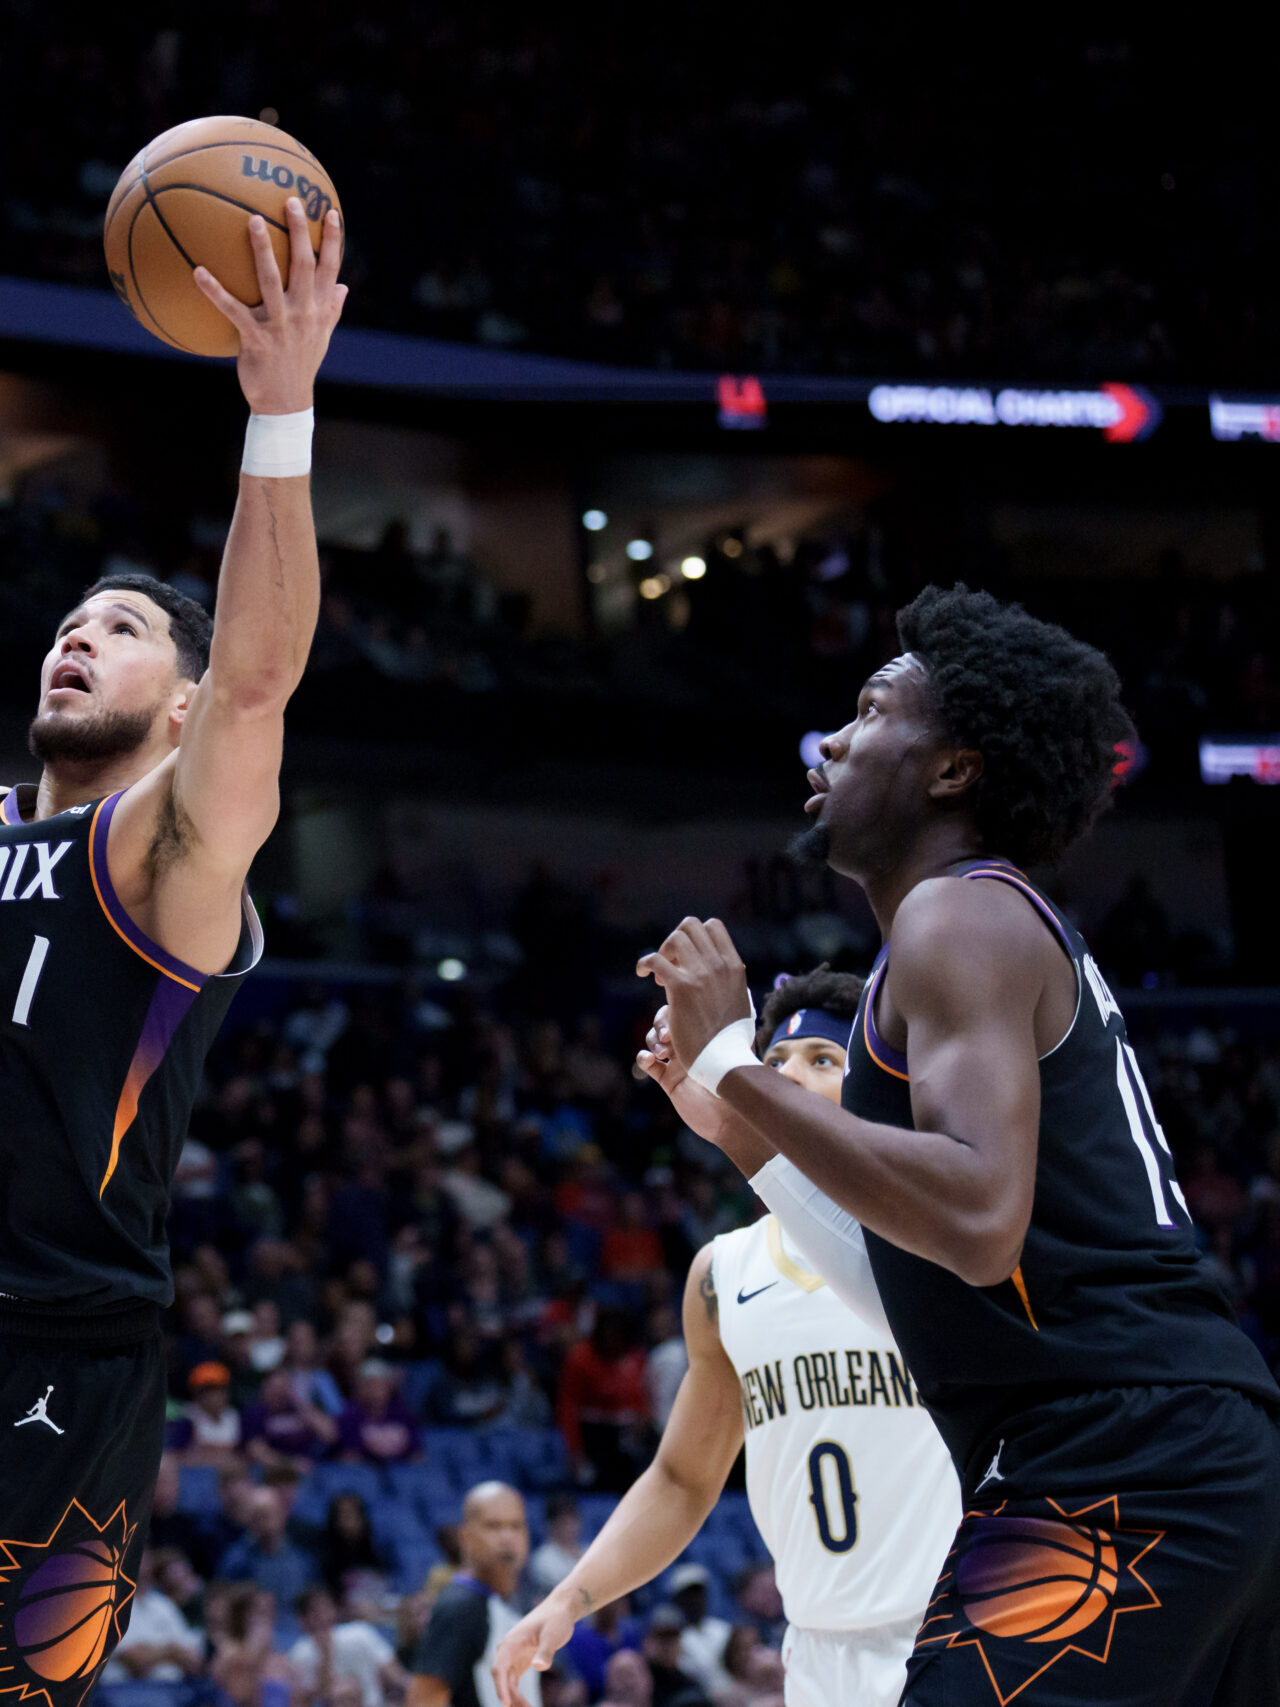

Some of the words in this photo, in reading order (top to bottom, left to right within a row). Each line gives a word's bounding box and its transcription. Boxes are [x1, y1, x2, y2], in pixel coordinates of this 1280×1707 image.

[11, 934, 51, 1027] 1
[793, 1349, 928, 1411] ORLEAN
[806, 1437, 860, 1557] 0
